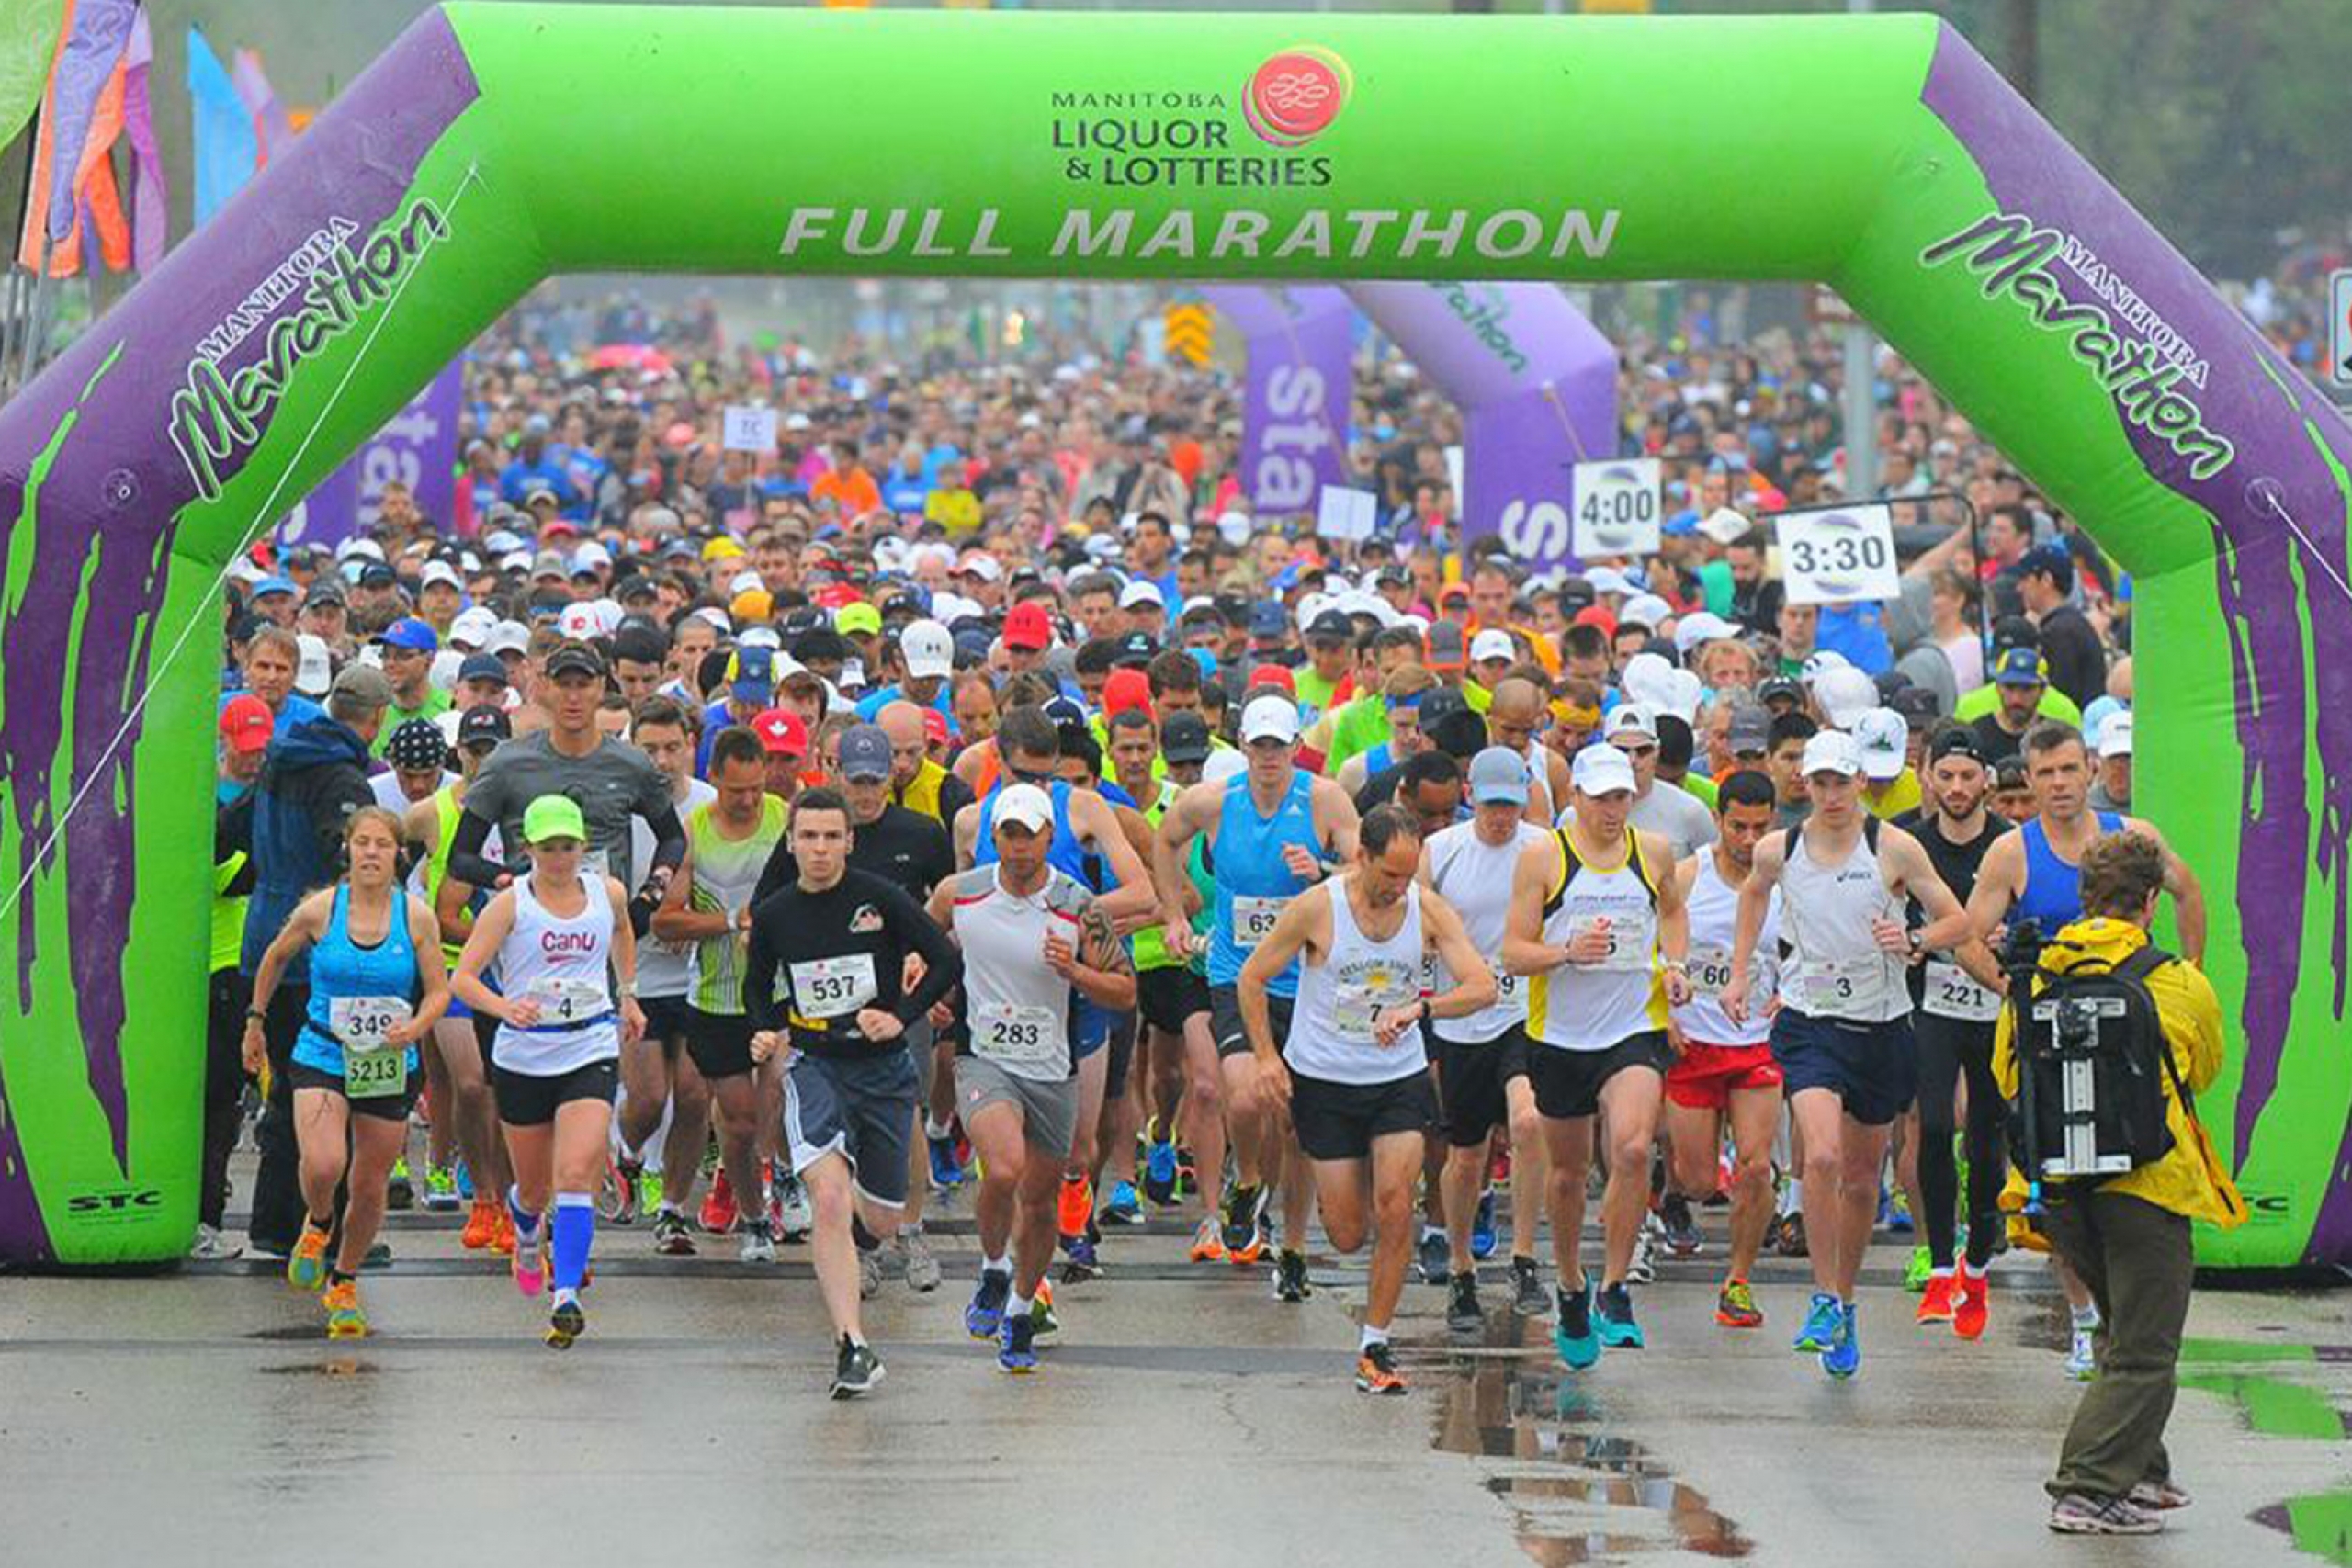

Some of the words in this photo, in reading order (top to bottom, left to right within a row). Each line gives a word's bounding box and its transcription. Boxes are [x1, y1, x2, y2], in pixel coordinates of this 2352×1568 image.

[1051, 93, 1226, 108] MANITOBA
[1051, 119, 1228, 154] LIQUOR
[1065, 157, 1093, 181] &
[1102, 157, 1333, 186] LOTTERIES
[778, 208, 1012, 256] FULL
[1048, 209, 1621, 258] MARATHON
[195, 216, 358, 366] MANITOBA
[2061, 235, 2210, 389] MANITOBA
[169, 197, 450, 502] Marathon
[1919, 213, 2234, 479] Marathon
[1581, 489, 1653, 525] 4:00
[1792, 536, 1885, 574] 3:30
[811, 975, 854, 1002] 537
[1837, 977, 1853, 998] 3
[1941, 982, 1984, 1007] 221
[557, 997, 572, 1019] 4
[1370, 1002, 1382, 1023] 7
[349, 1013, 393, 1037] 349
[992, 1021, 1039, 1047] 283
[68, 1190, 161, 1212] STC
